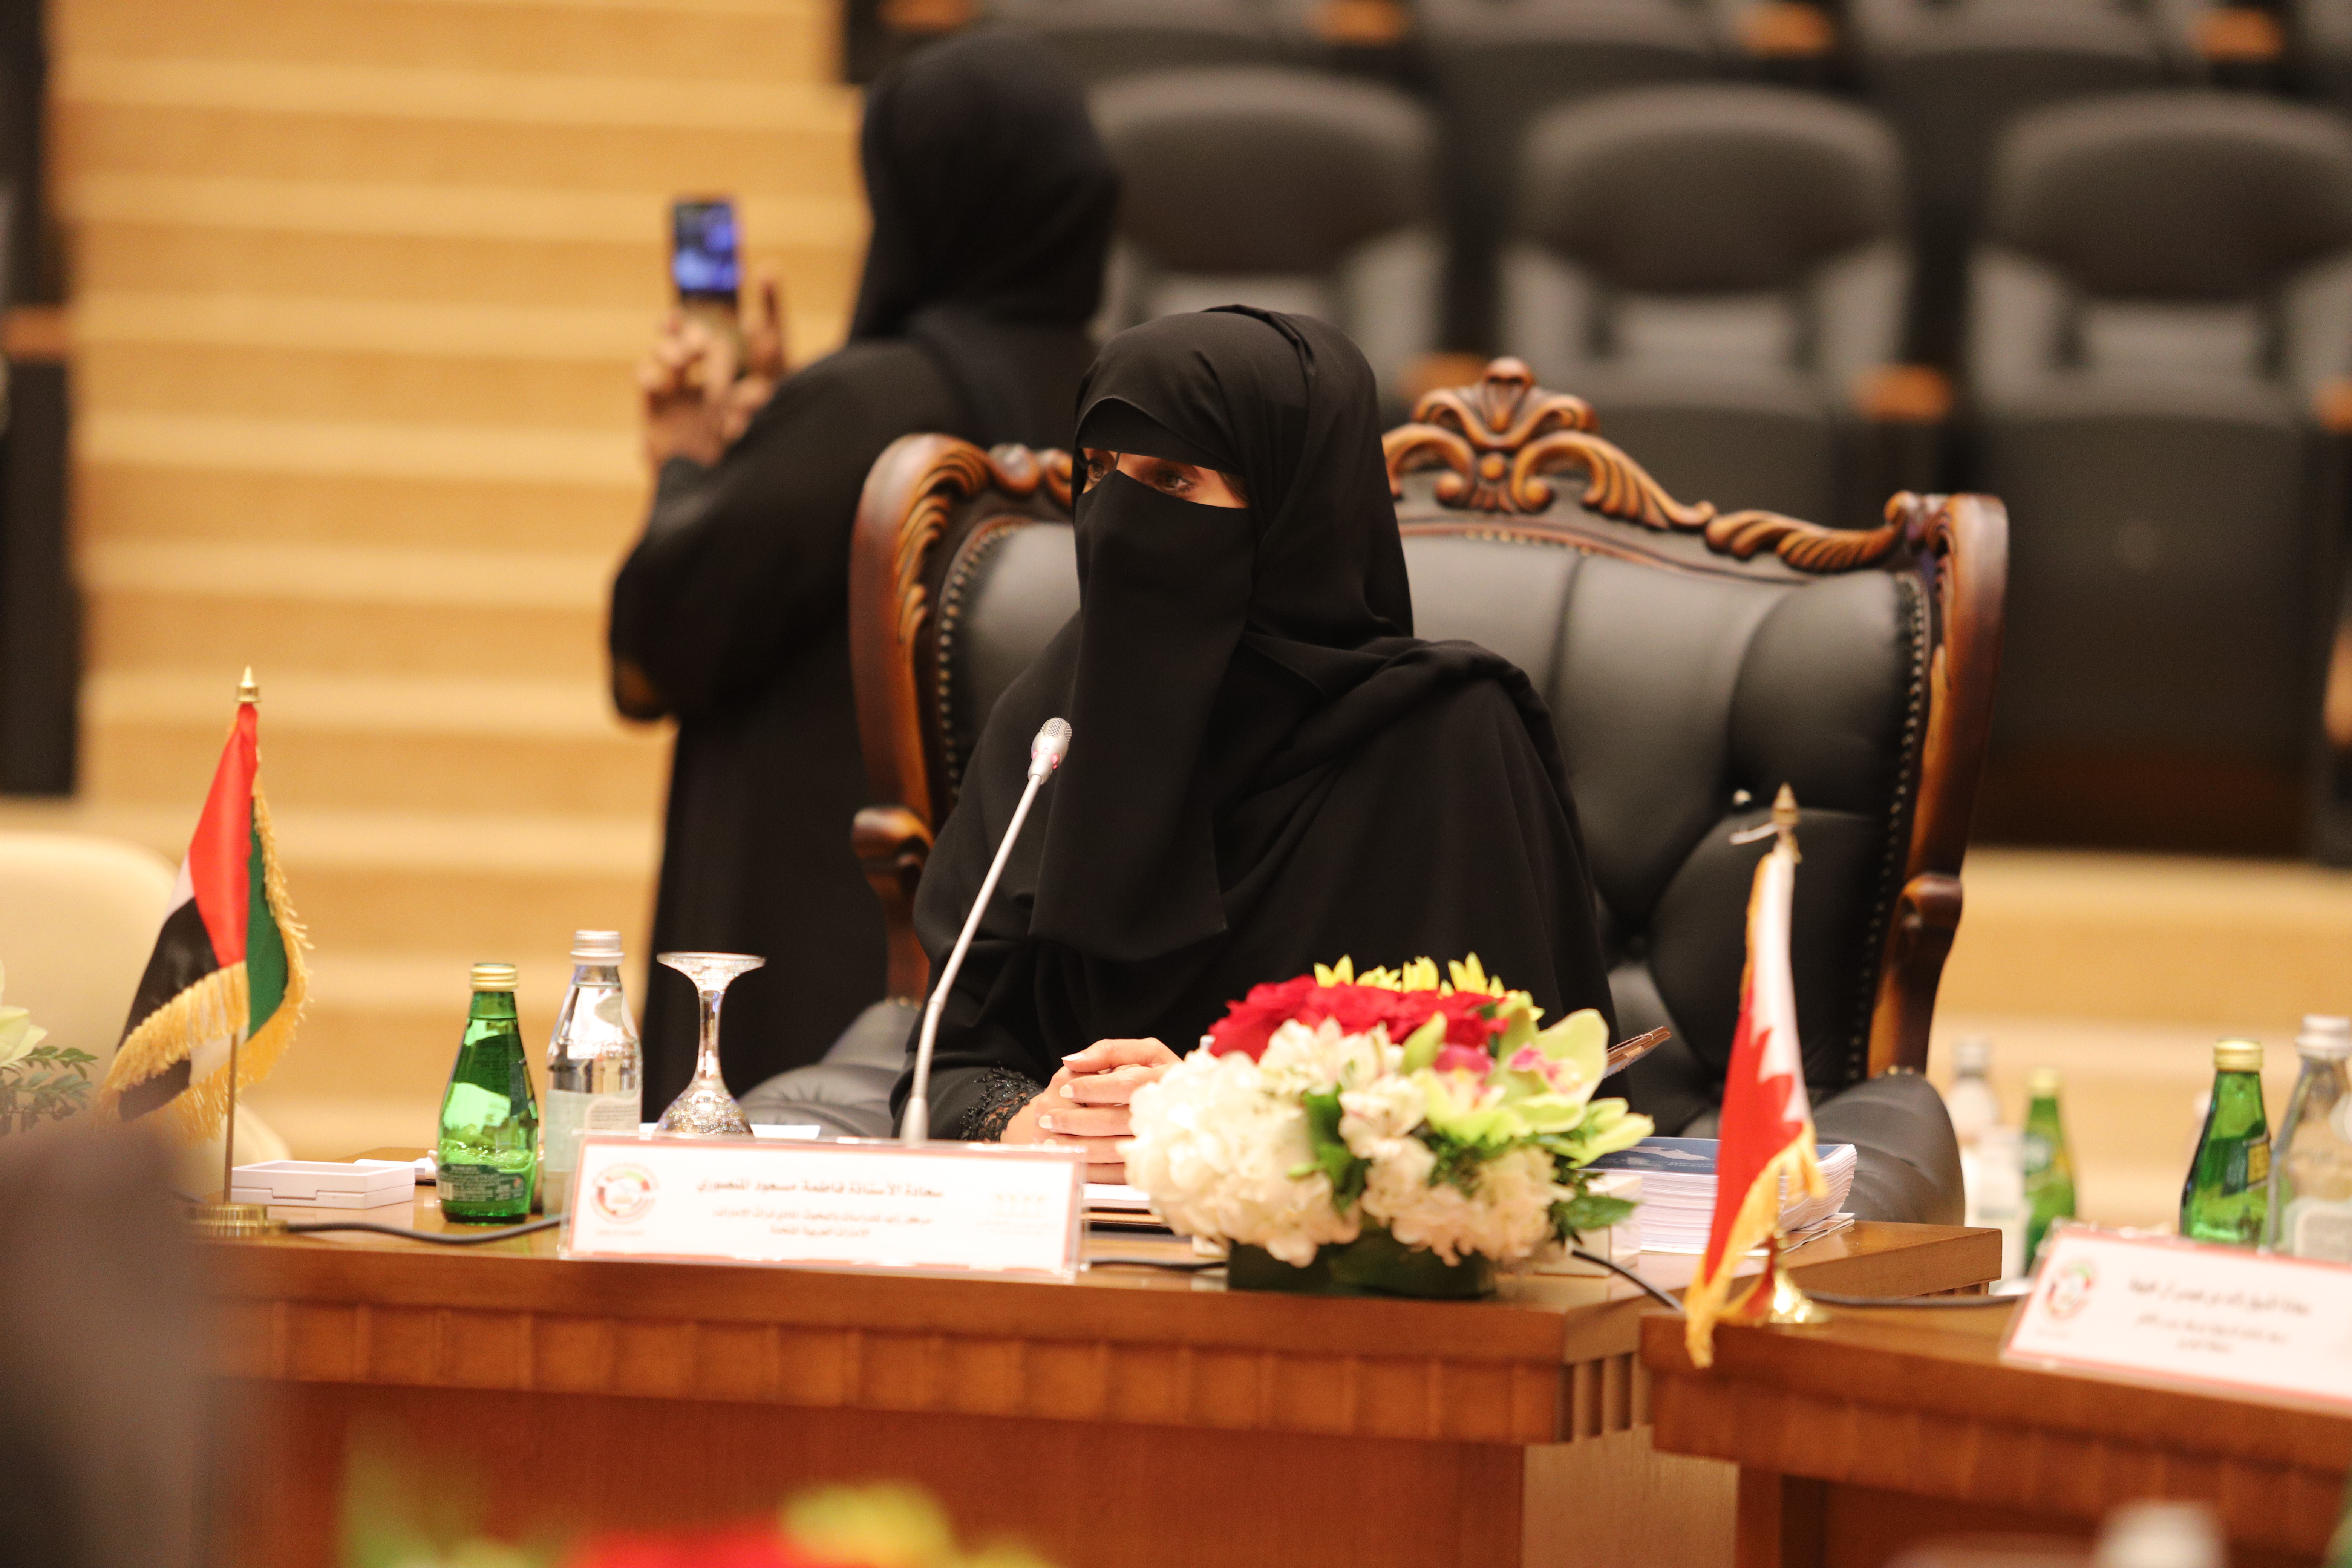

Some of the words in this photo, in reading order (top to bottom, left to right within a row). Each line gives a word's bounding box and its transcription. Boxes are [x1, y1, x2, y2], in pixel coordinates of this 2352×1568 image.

[697, 1176, 752, 1194] المنصوري
[754, 1180, 796, 1195] مسعود
[801, 1177, 844, 1194] فاطمة
[904, 1183, 943, 1197] سعادة
